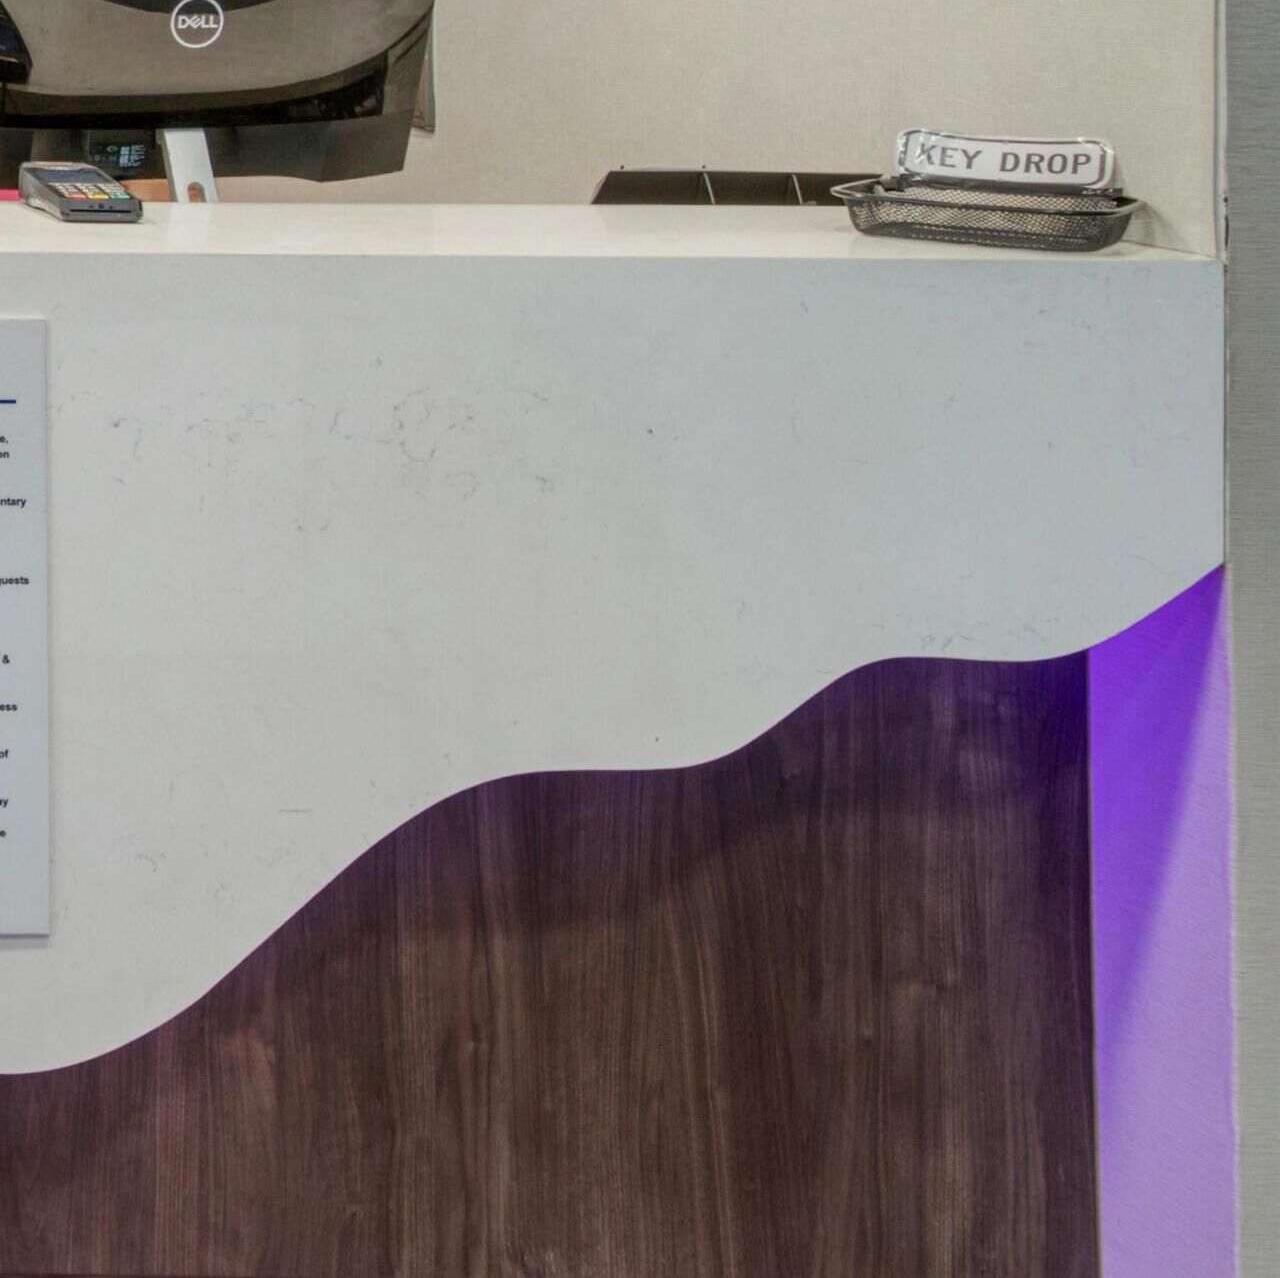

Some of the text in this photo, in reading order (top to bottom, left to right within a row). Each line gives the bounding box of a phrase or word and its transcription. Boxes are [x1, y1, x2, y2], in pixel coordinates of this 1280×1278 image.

[178, 15, 217, 29] DELL
[916, 142, 1091, 175] KEY DROP
